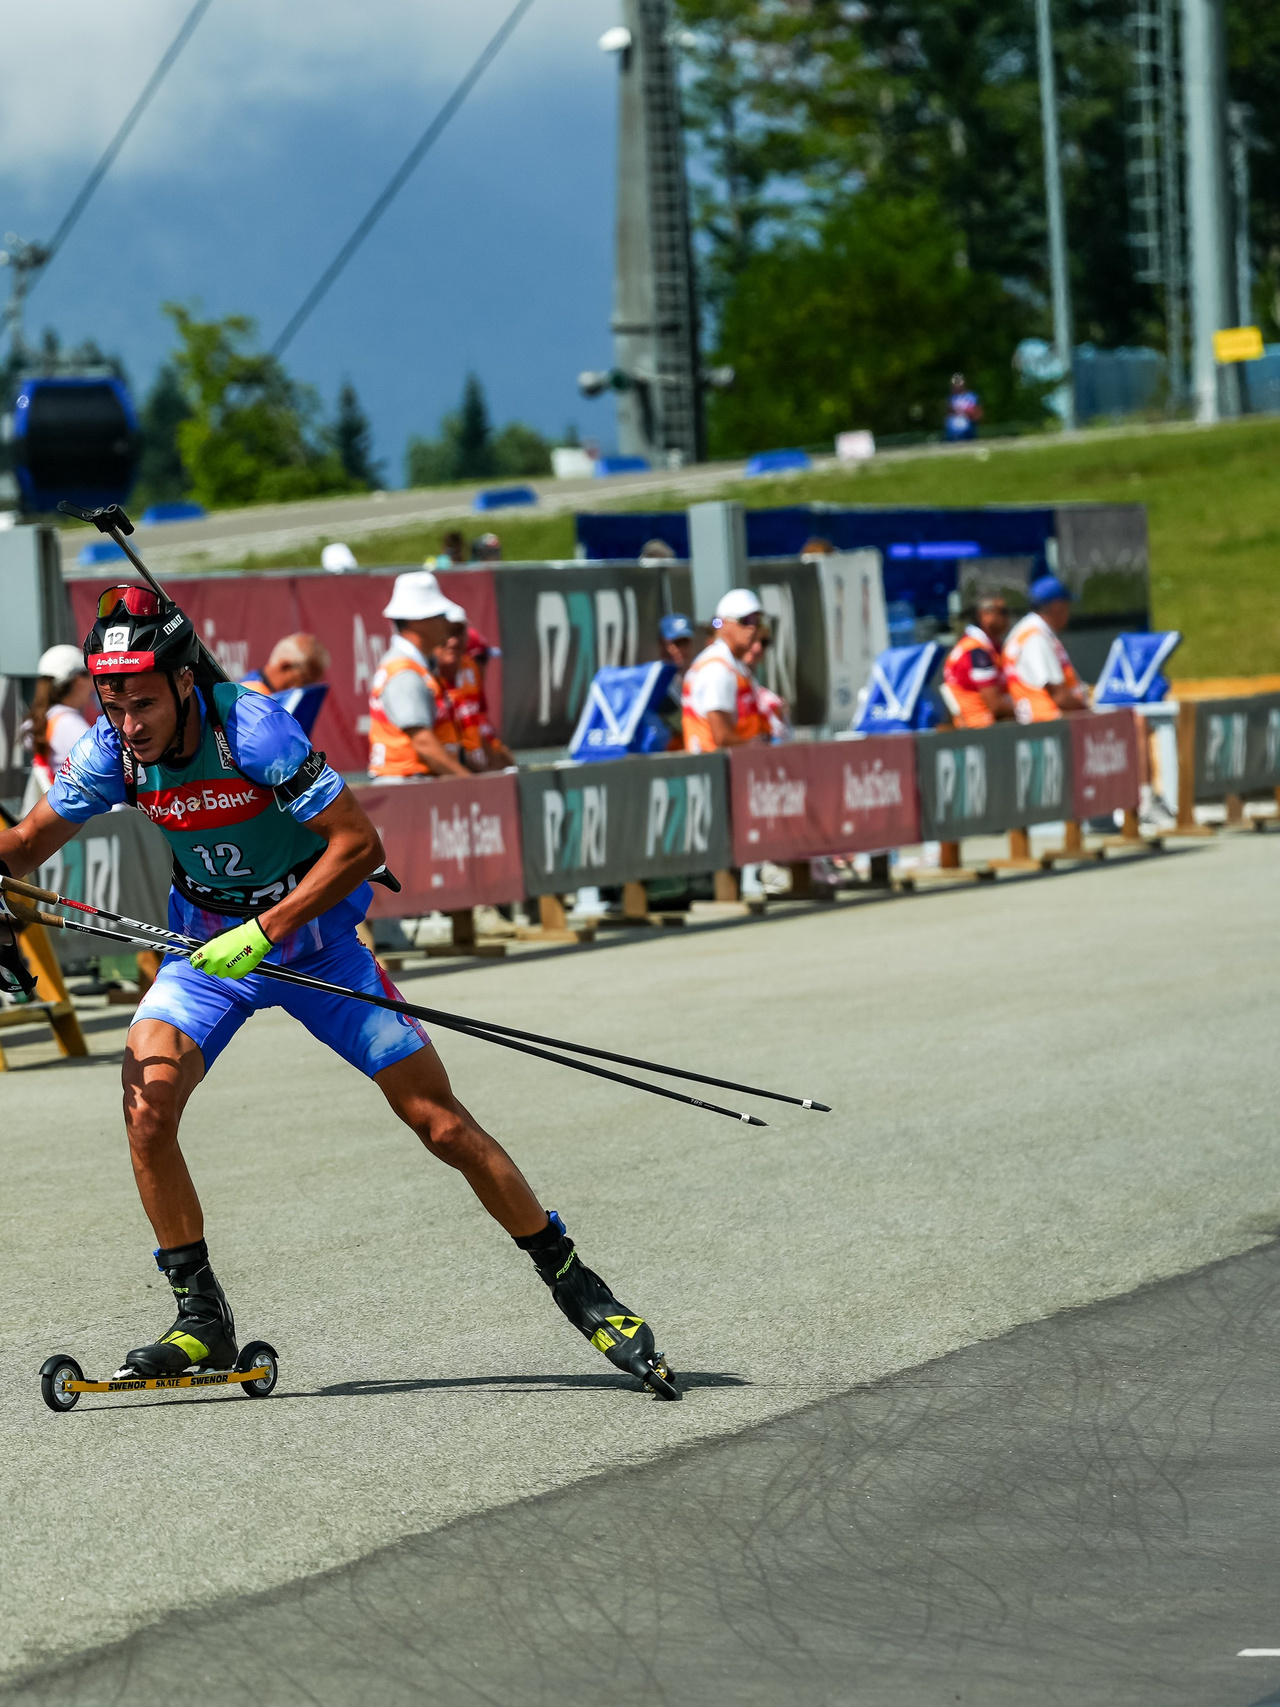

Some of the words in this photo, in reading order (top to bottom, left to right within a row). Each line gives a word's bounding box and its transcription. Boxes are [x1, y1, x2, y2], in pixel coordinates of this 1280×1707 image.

[107, 632, 125, 646] 12
[96, 657, 118, 667] Альфа
[119, 656, 140, 665] Банк
[136, 795, 201, 820] Альфа
[202, 789, 259, 811] Банк
[646, 773, 713, 859] PARI
[542, 784, 608, 875] PARI
[192, 842, 254, 877] 12
[108, 1380, 147, 1391] SWENOR
[155, 1378, 181, 1388] SKATE
[190, 1374, 229, 1386] SWENOR
